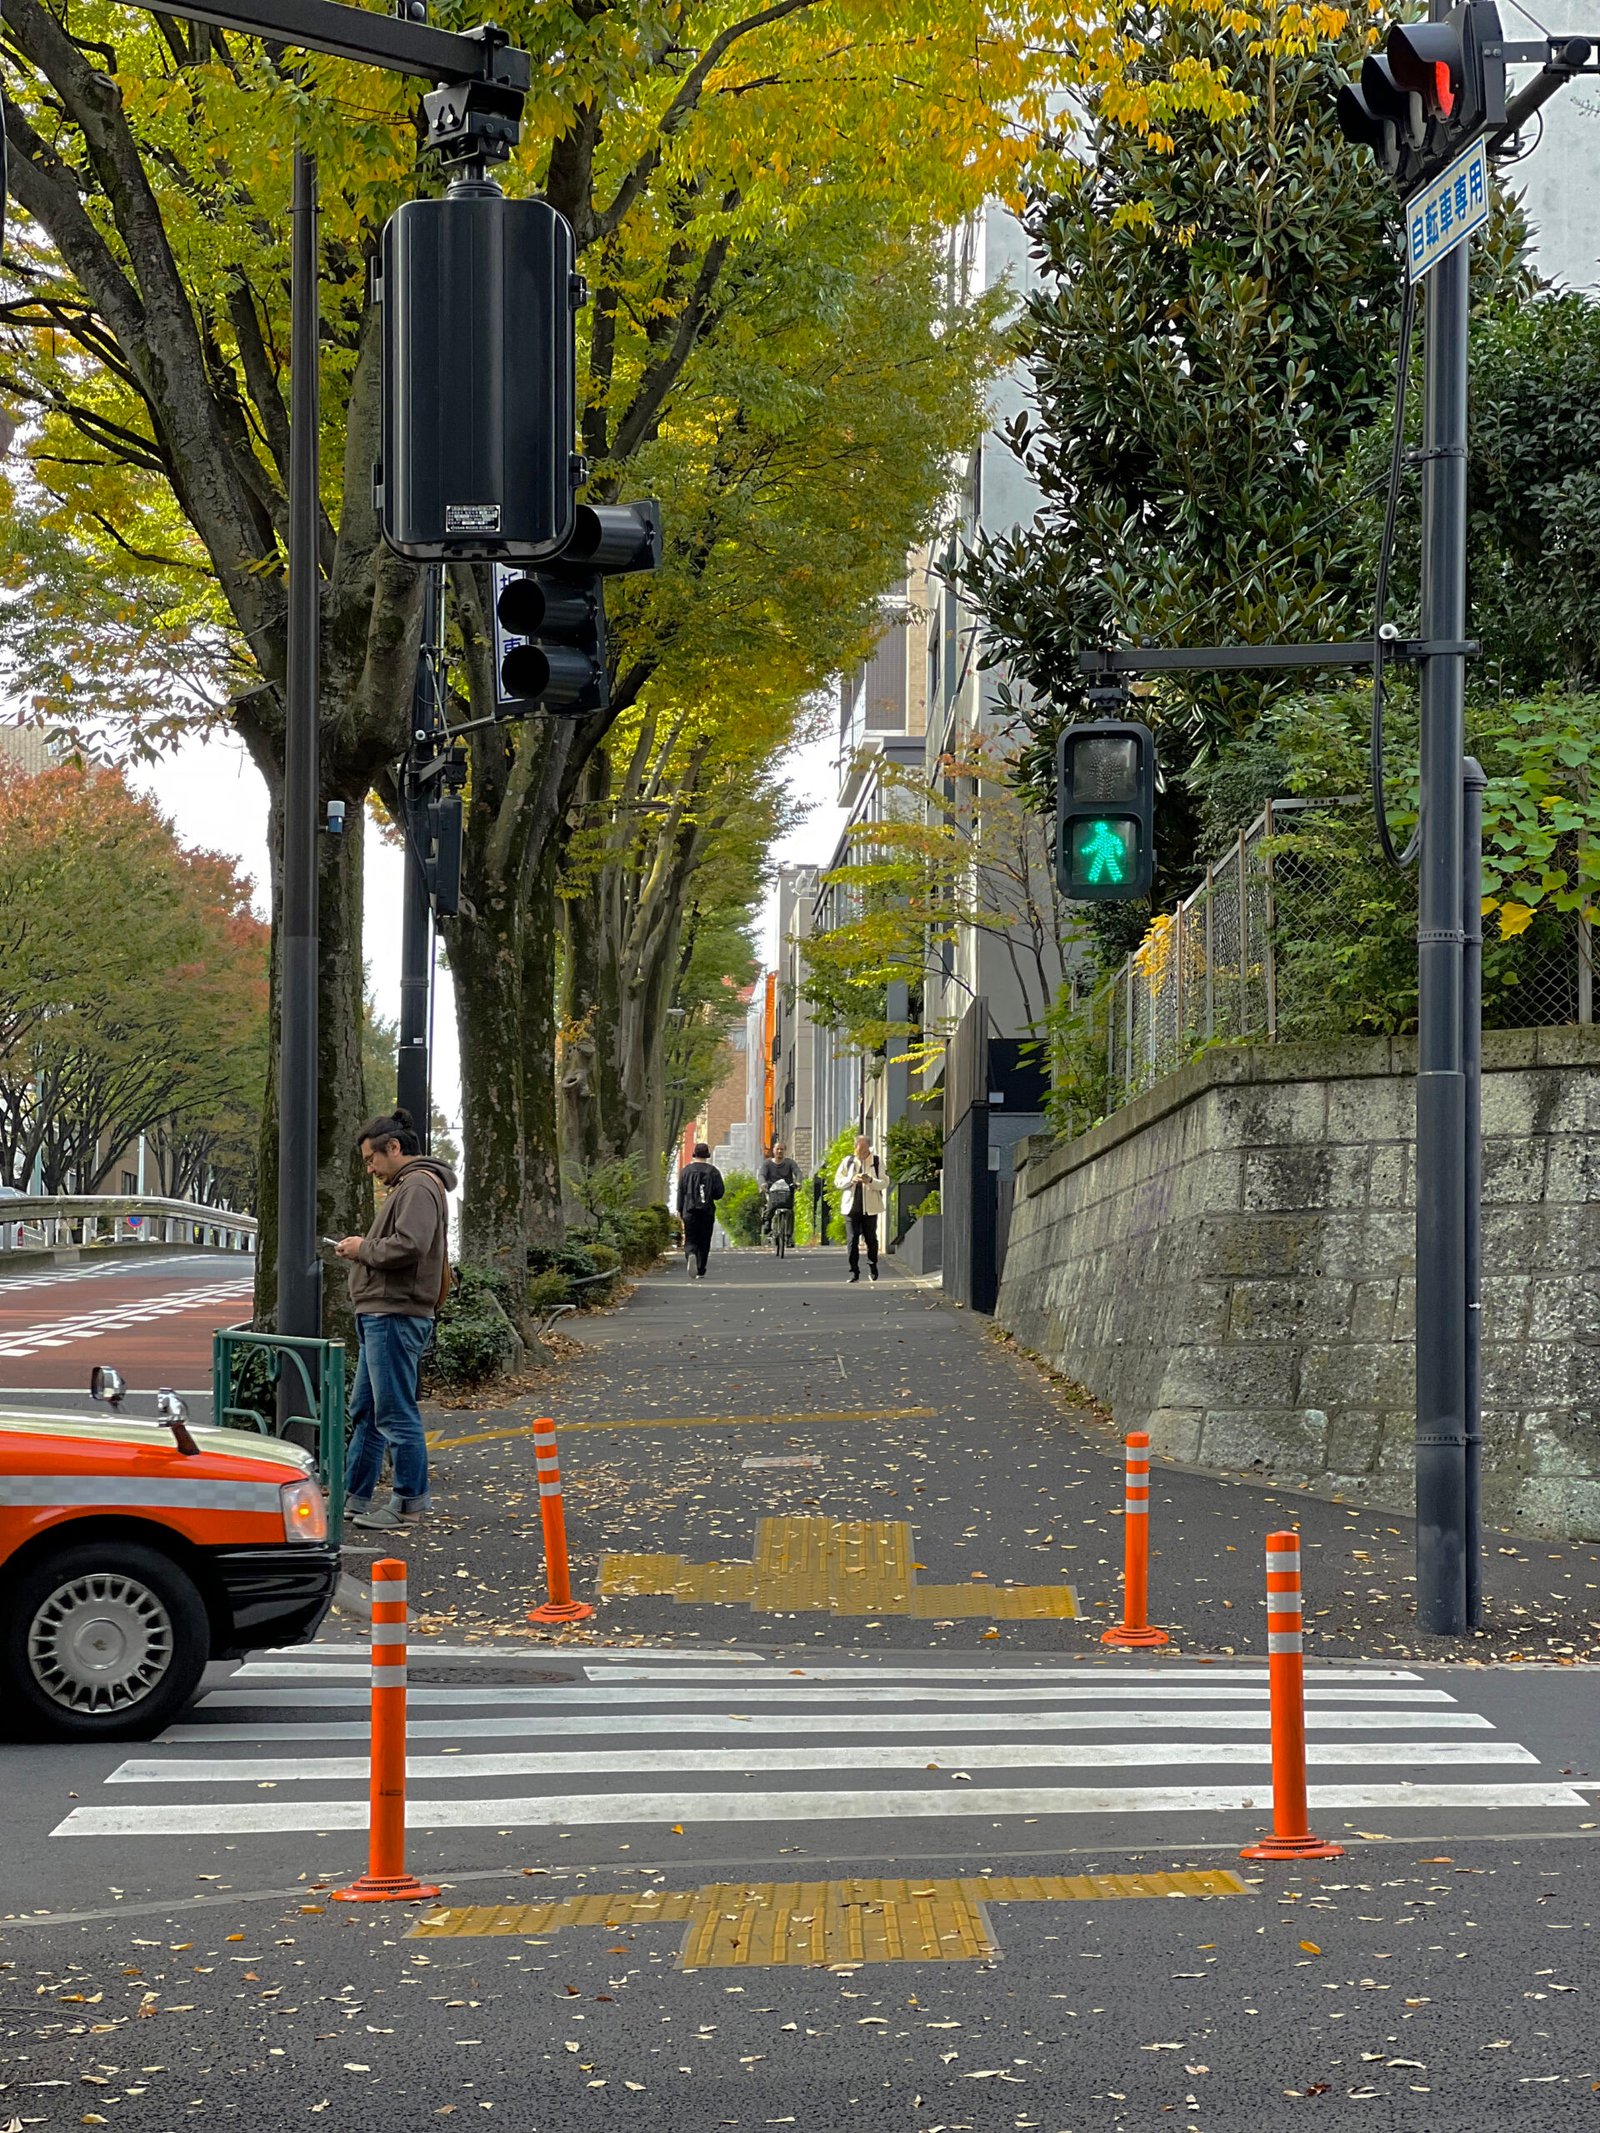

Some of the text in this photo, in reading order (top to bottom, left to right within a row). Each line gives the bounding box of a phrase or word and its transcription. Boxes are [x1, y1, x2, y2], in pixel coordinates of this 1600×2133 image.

[1412, 158, 1483, 261] 自転車専用
